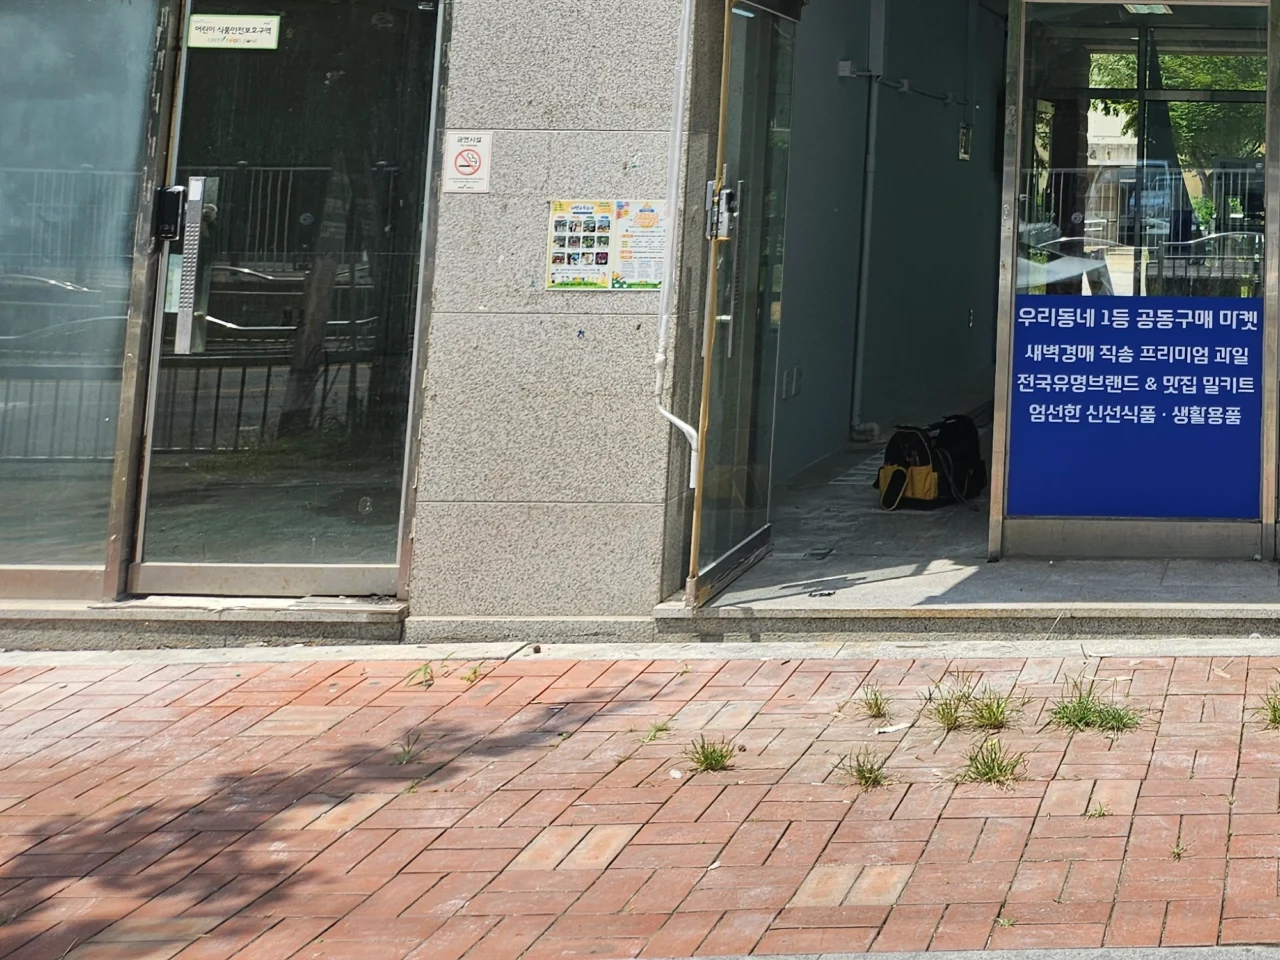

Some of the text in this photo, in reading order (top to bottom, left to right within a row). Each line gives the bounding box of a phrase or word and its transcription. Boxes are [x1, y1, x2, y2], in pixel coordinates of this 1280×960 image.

[1018, 307, 1258, 331] 우리동네 1등 공동구매 마켓
[1025, 344, 1249, 366] 새벽경매 직송 프리미엄 과일
[1017, 373, 1255, 395] 전국유명브랜드 & 맛집 밀키트
[1029, 403, 1242, 425] 엄선한 신선식품 생활용품
